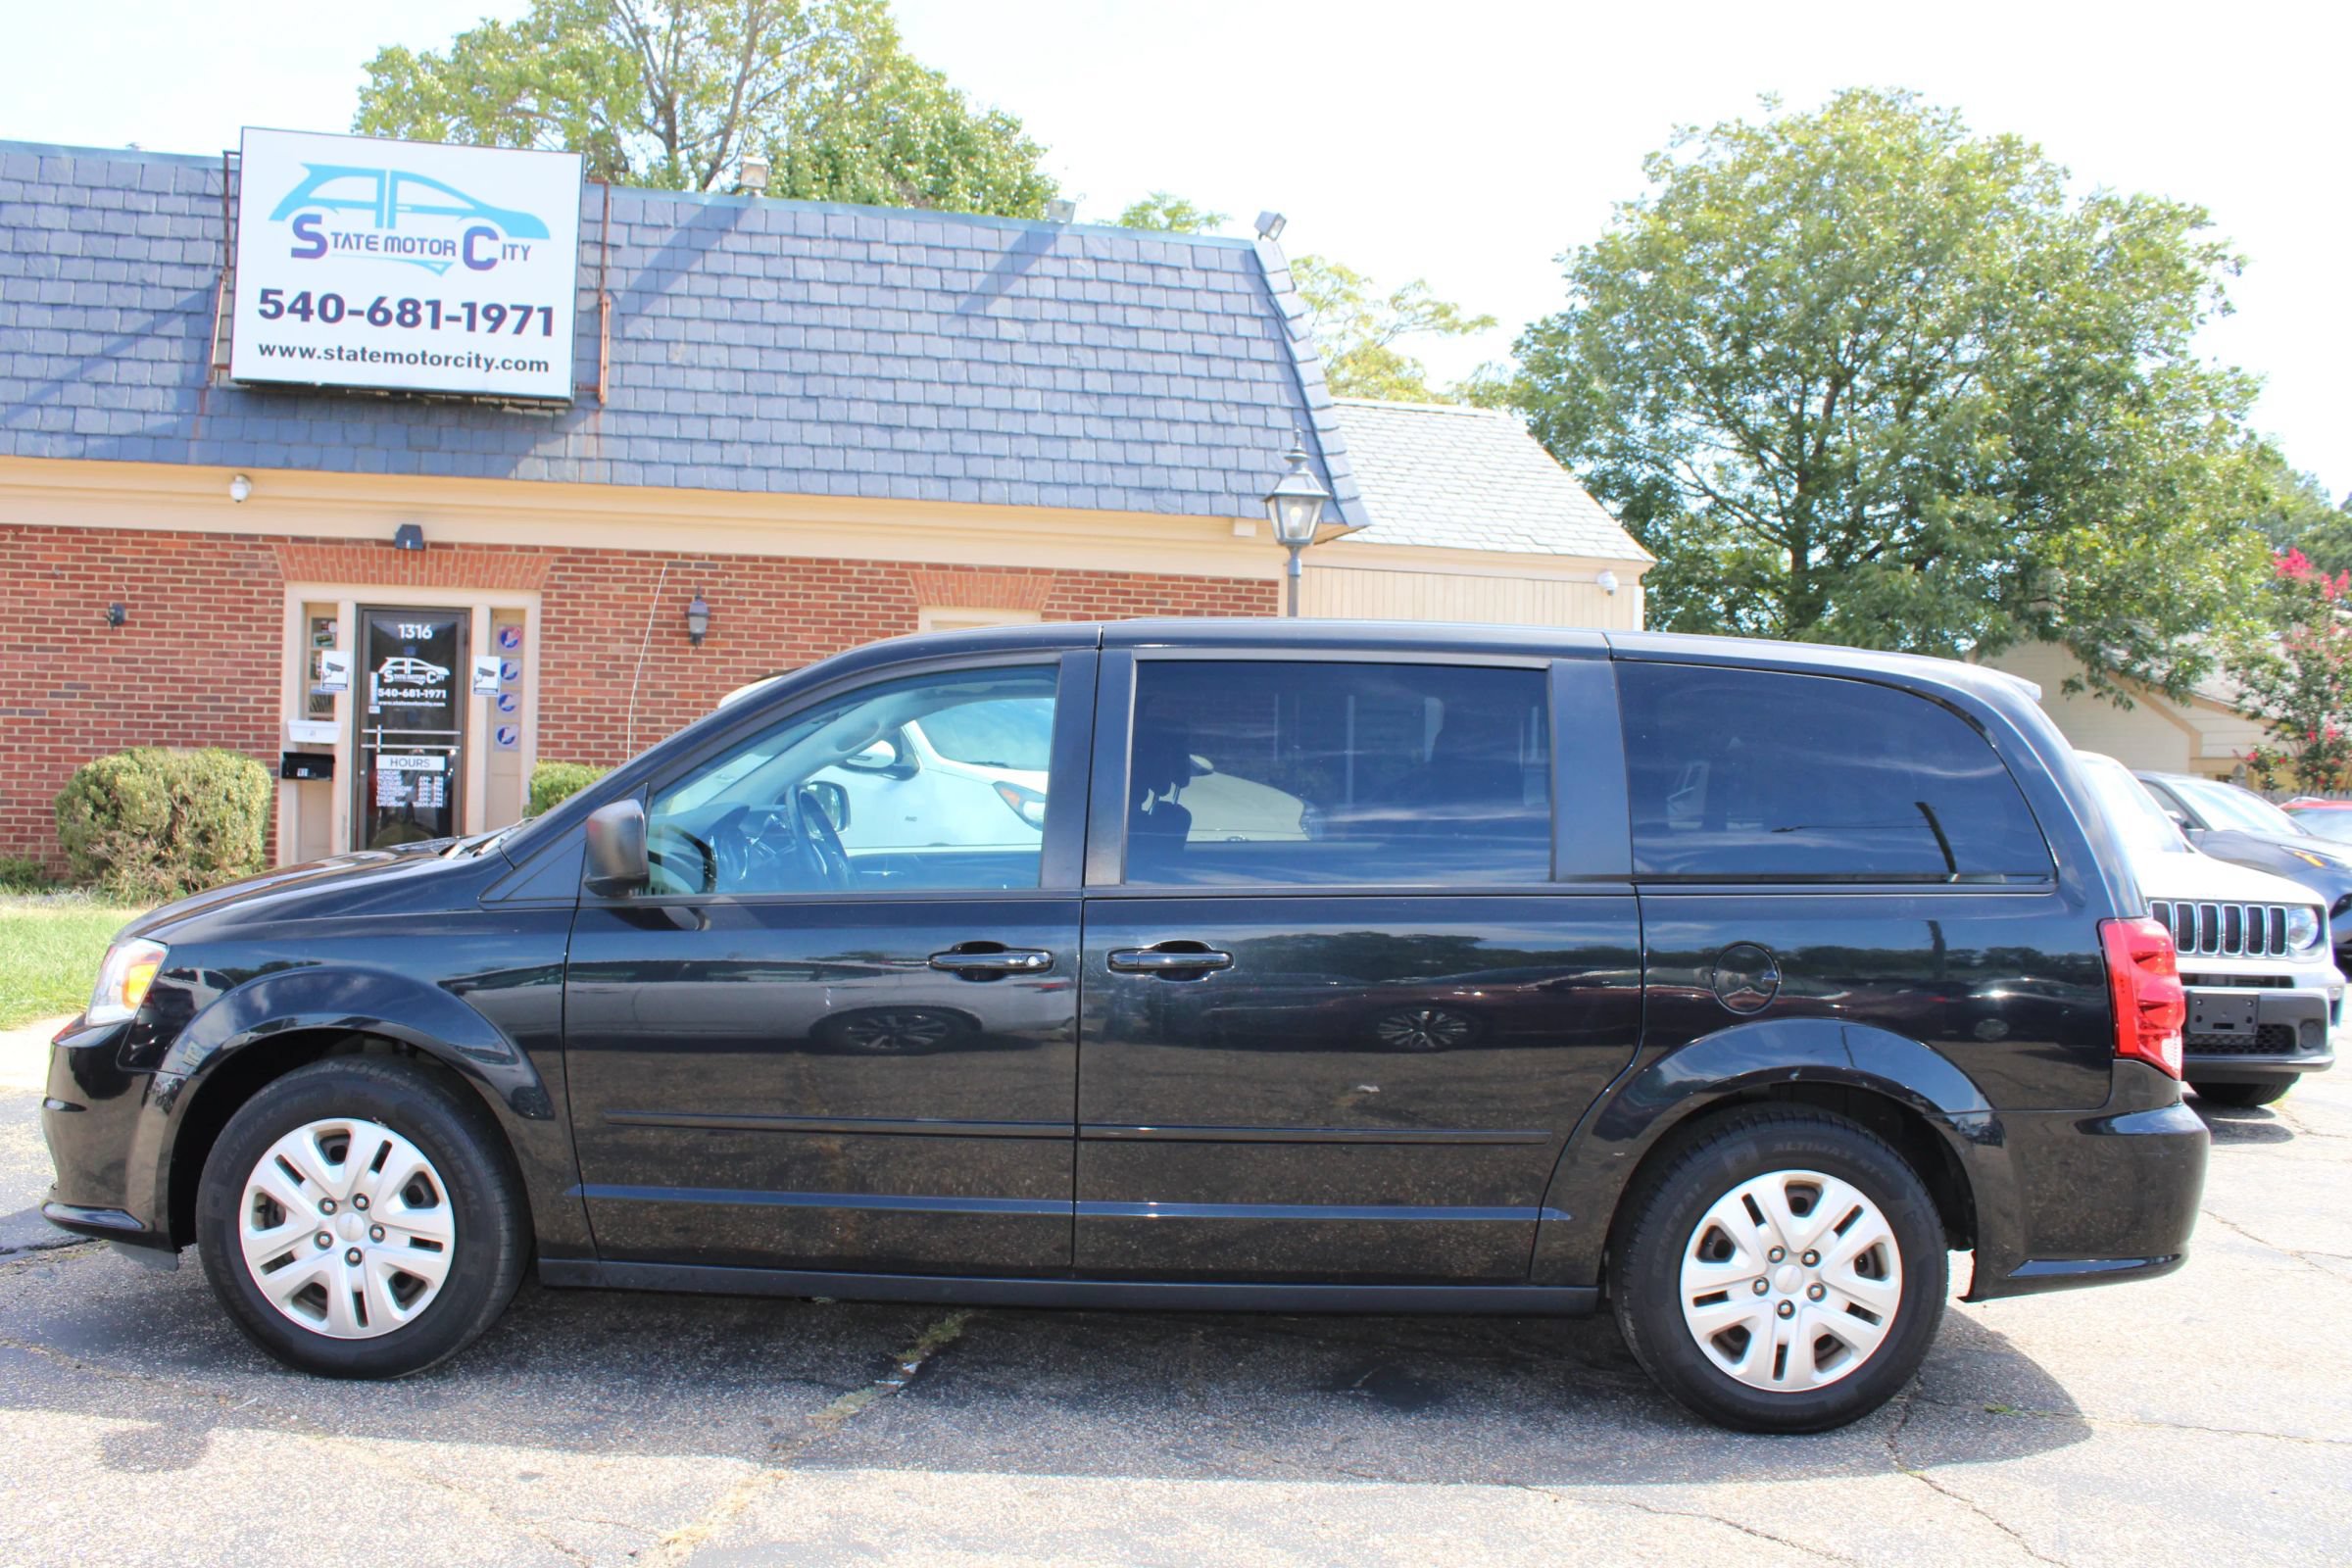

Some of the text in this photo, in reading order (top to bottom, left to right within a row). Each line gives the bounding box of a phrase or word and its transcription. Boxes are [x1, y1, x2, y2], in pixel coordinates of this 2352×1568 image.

[383, 235, 457, 257] MOTOR
[258, 288, 554, 337] 540-681-1971
[258, 343, 550, 372] www.statemotorcity.com
[398, 624, 433, 639] 1316
[377, 688, 447, 699] 540-681-1971
[390, 758, 431, 767] HOURS
